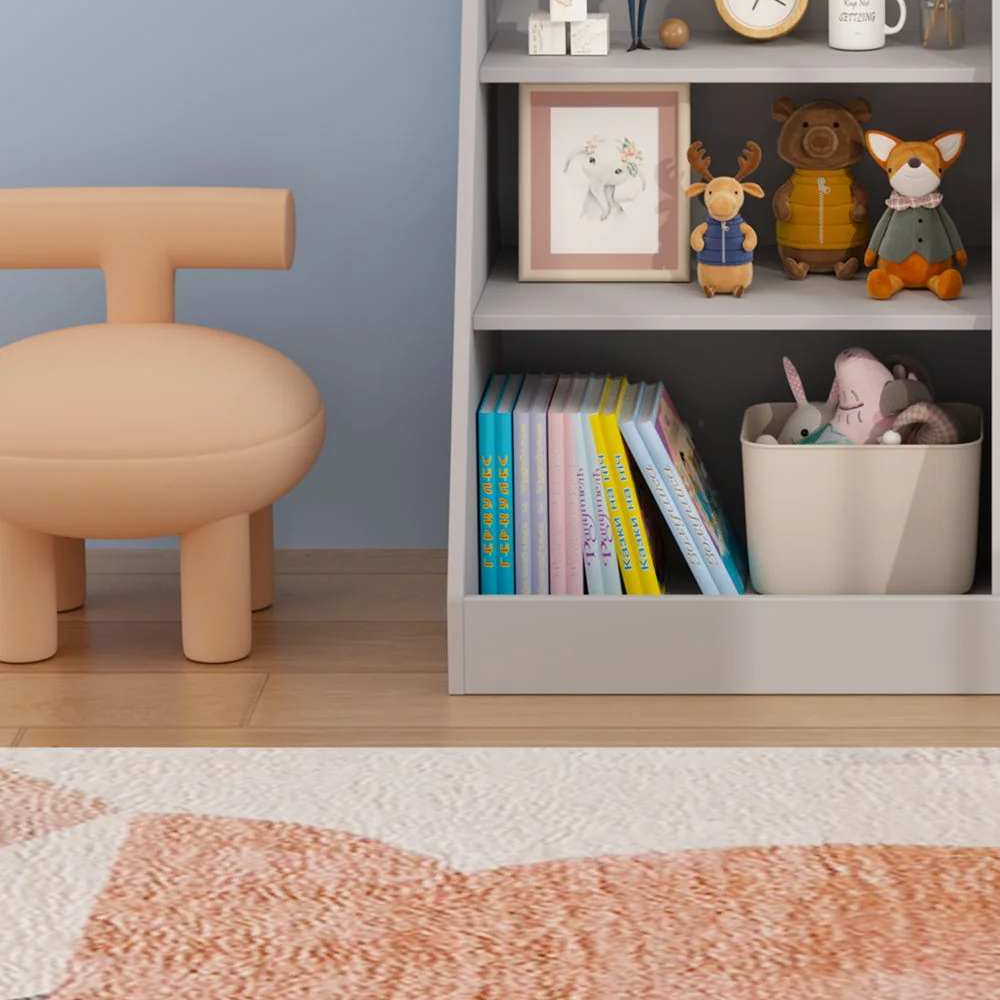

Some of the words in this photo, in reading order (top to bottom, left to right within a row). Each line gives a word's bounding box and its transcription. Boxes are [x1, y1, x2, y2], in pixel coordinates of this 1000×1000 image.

[597, 454, 611, 482] ніч
[614, 454, 628, 482] ніч
[481, 455, 494, 568] ГЕРКУЛЕС
[497, 455, 511, 568] ГЕРКУЛЕС
[606, 487, 617, 511] на
[622, 487, 635, 511] на
[613, 515, 633, 571] Казки
[630, 515, 650, 571] Казки
